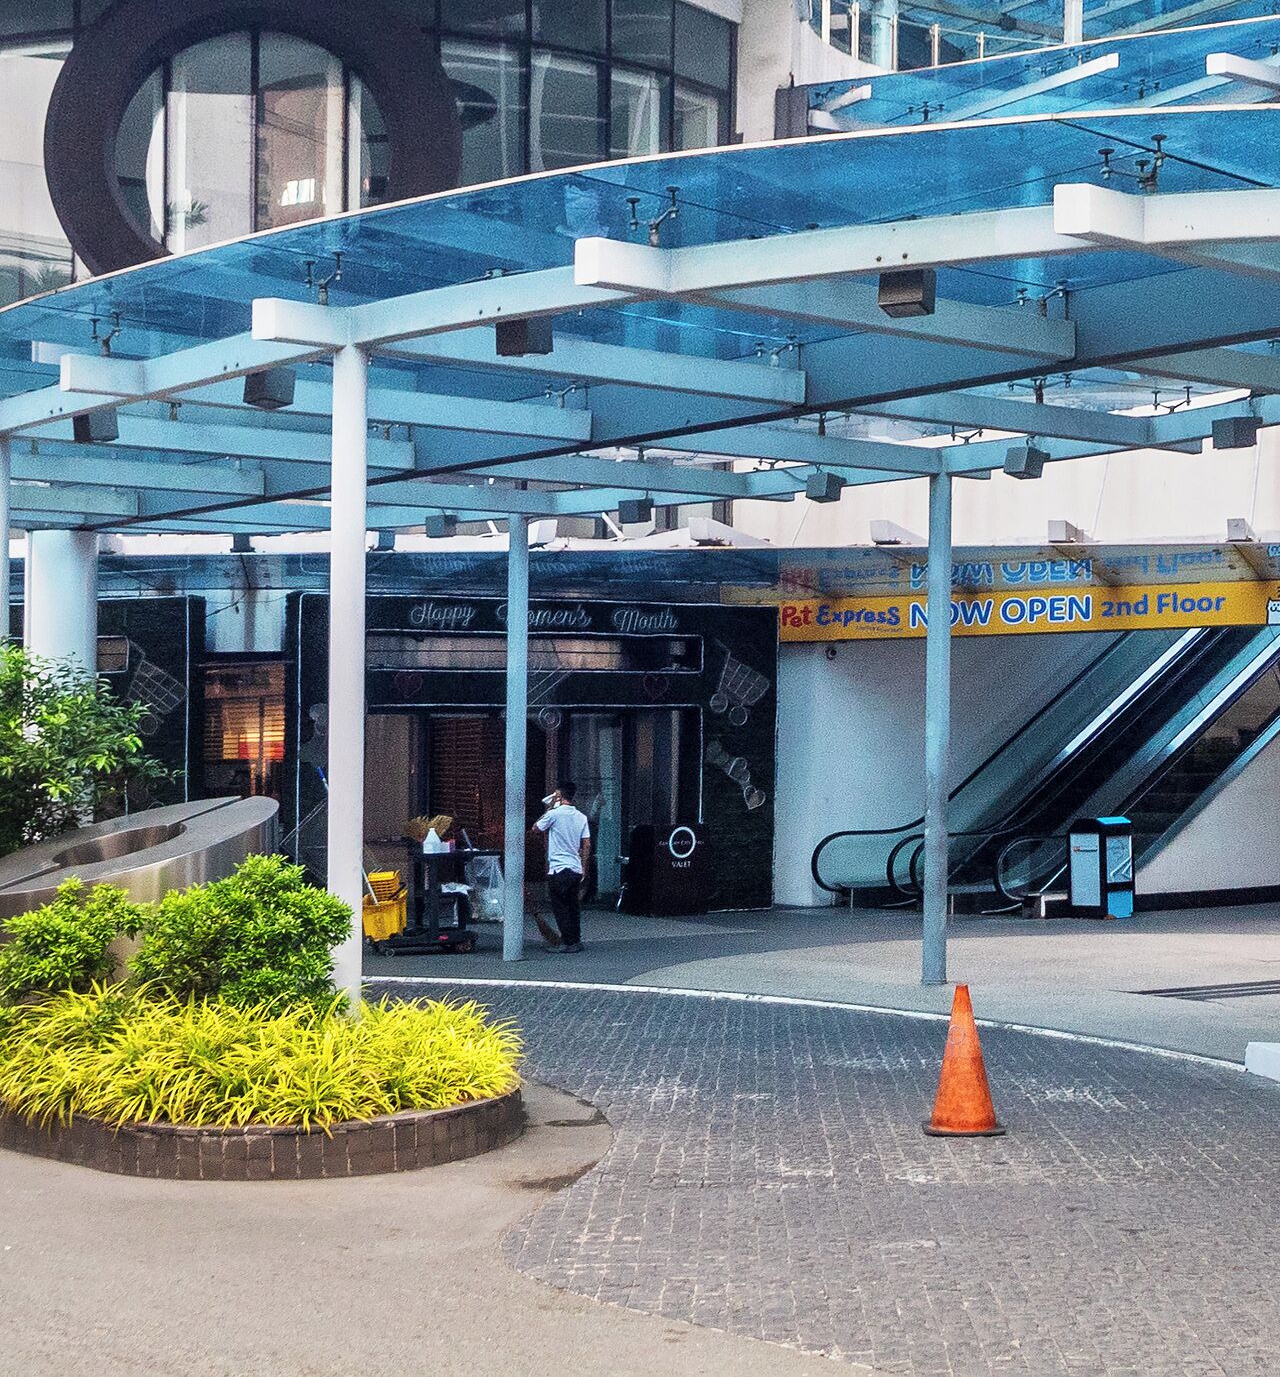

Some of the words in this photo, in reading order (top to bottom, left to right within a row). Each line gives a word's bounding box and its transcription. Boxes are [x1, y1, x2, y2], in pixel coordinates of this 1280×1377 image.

[410, 601, 477, 627] Happy
[613, 607, 680, 631] Month
[780, 605, 812, 629] Pet
[1001, 594, 1093, 626] OPEN
[1101, 595, 1149, 618] 2nd
[1156, 591, 1227, 615] Floor
